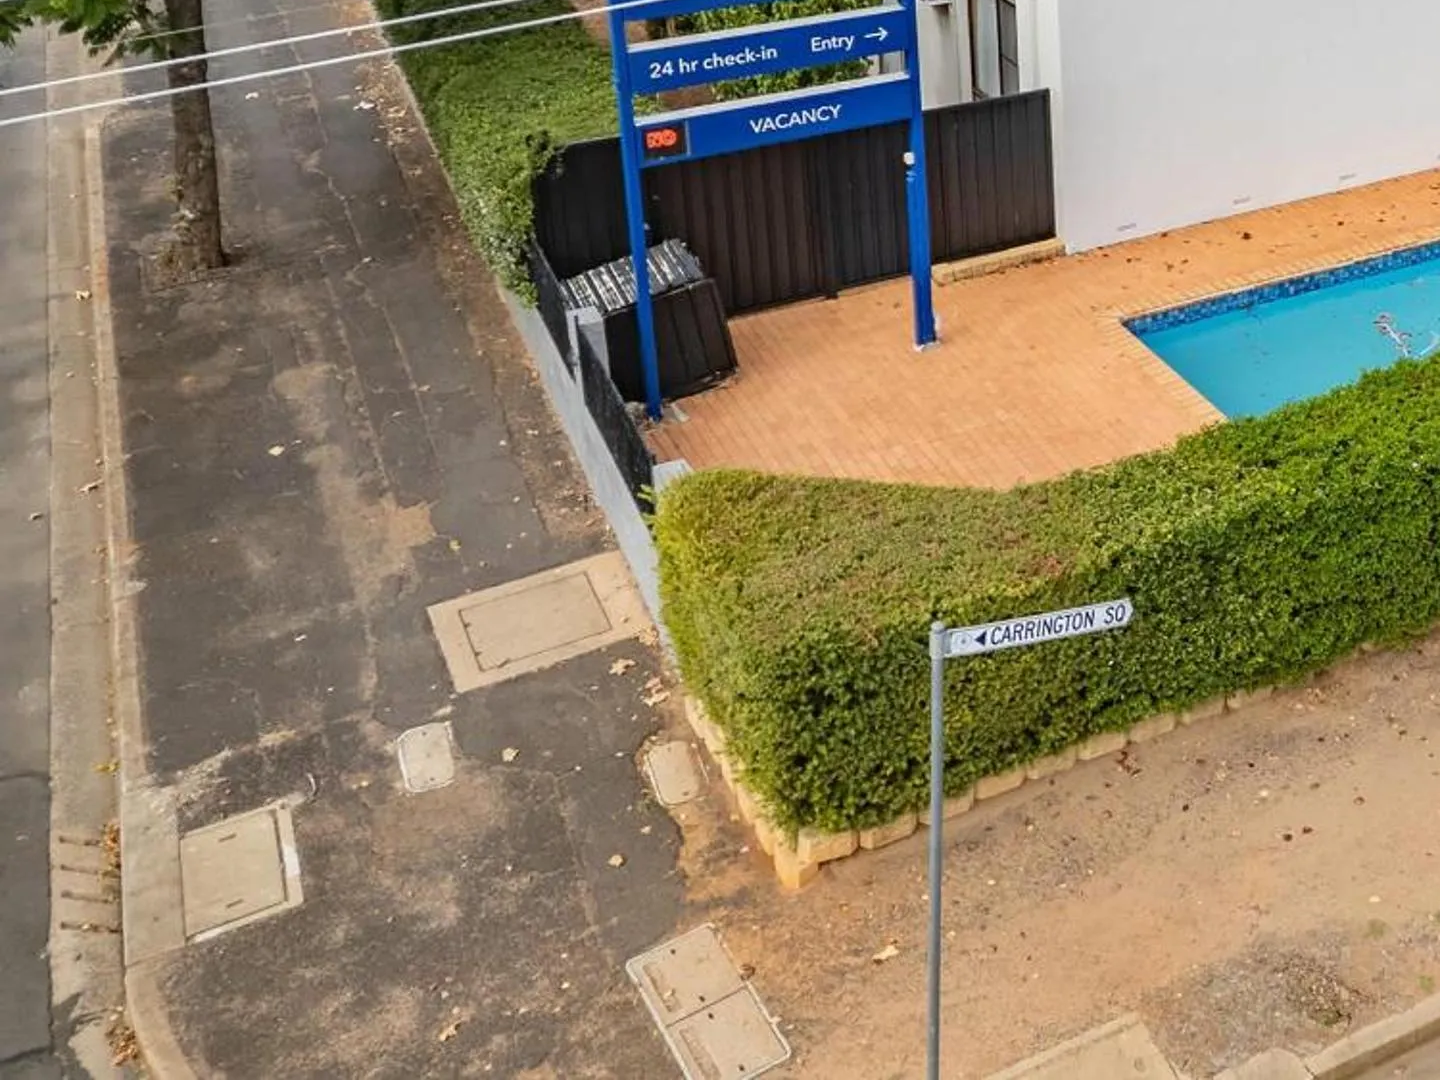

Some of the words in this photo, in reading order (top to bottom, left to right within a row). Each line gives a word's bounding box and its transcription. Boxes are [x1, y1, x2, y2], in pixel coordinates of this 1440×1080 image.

[811, 35, 855, 52] Entry
[650, 62, 673, 79] 24
[679, 57, 698, 73] hr
[702, 46, 777, 70] check-in
[750, 104, 842, 134] VACANCY
[991, 609, 1096, 646] CARRINGTON
